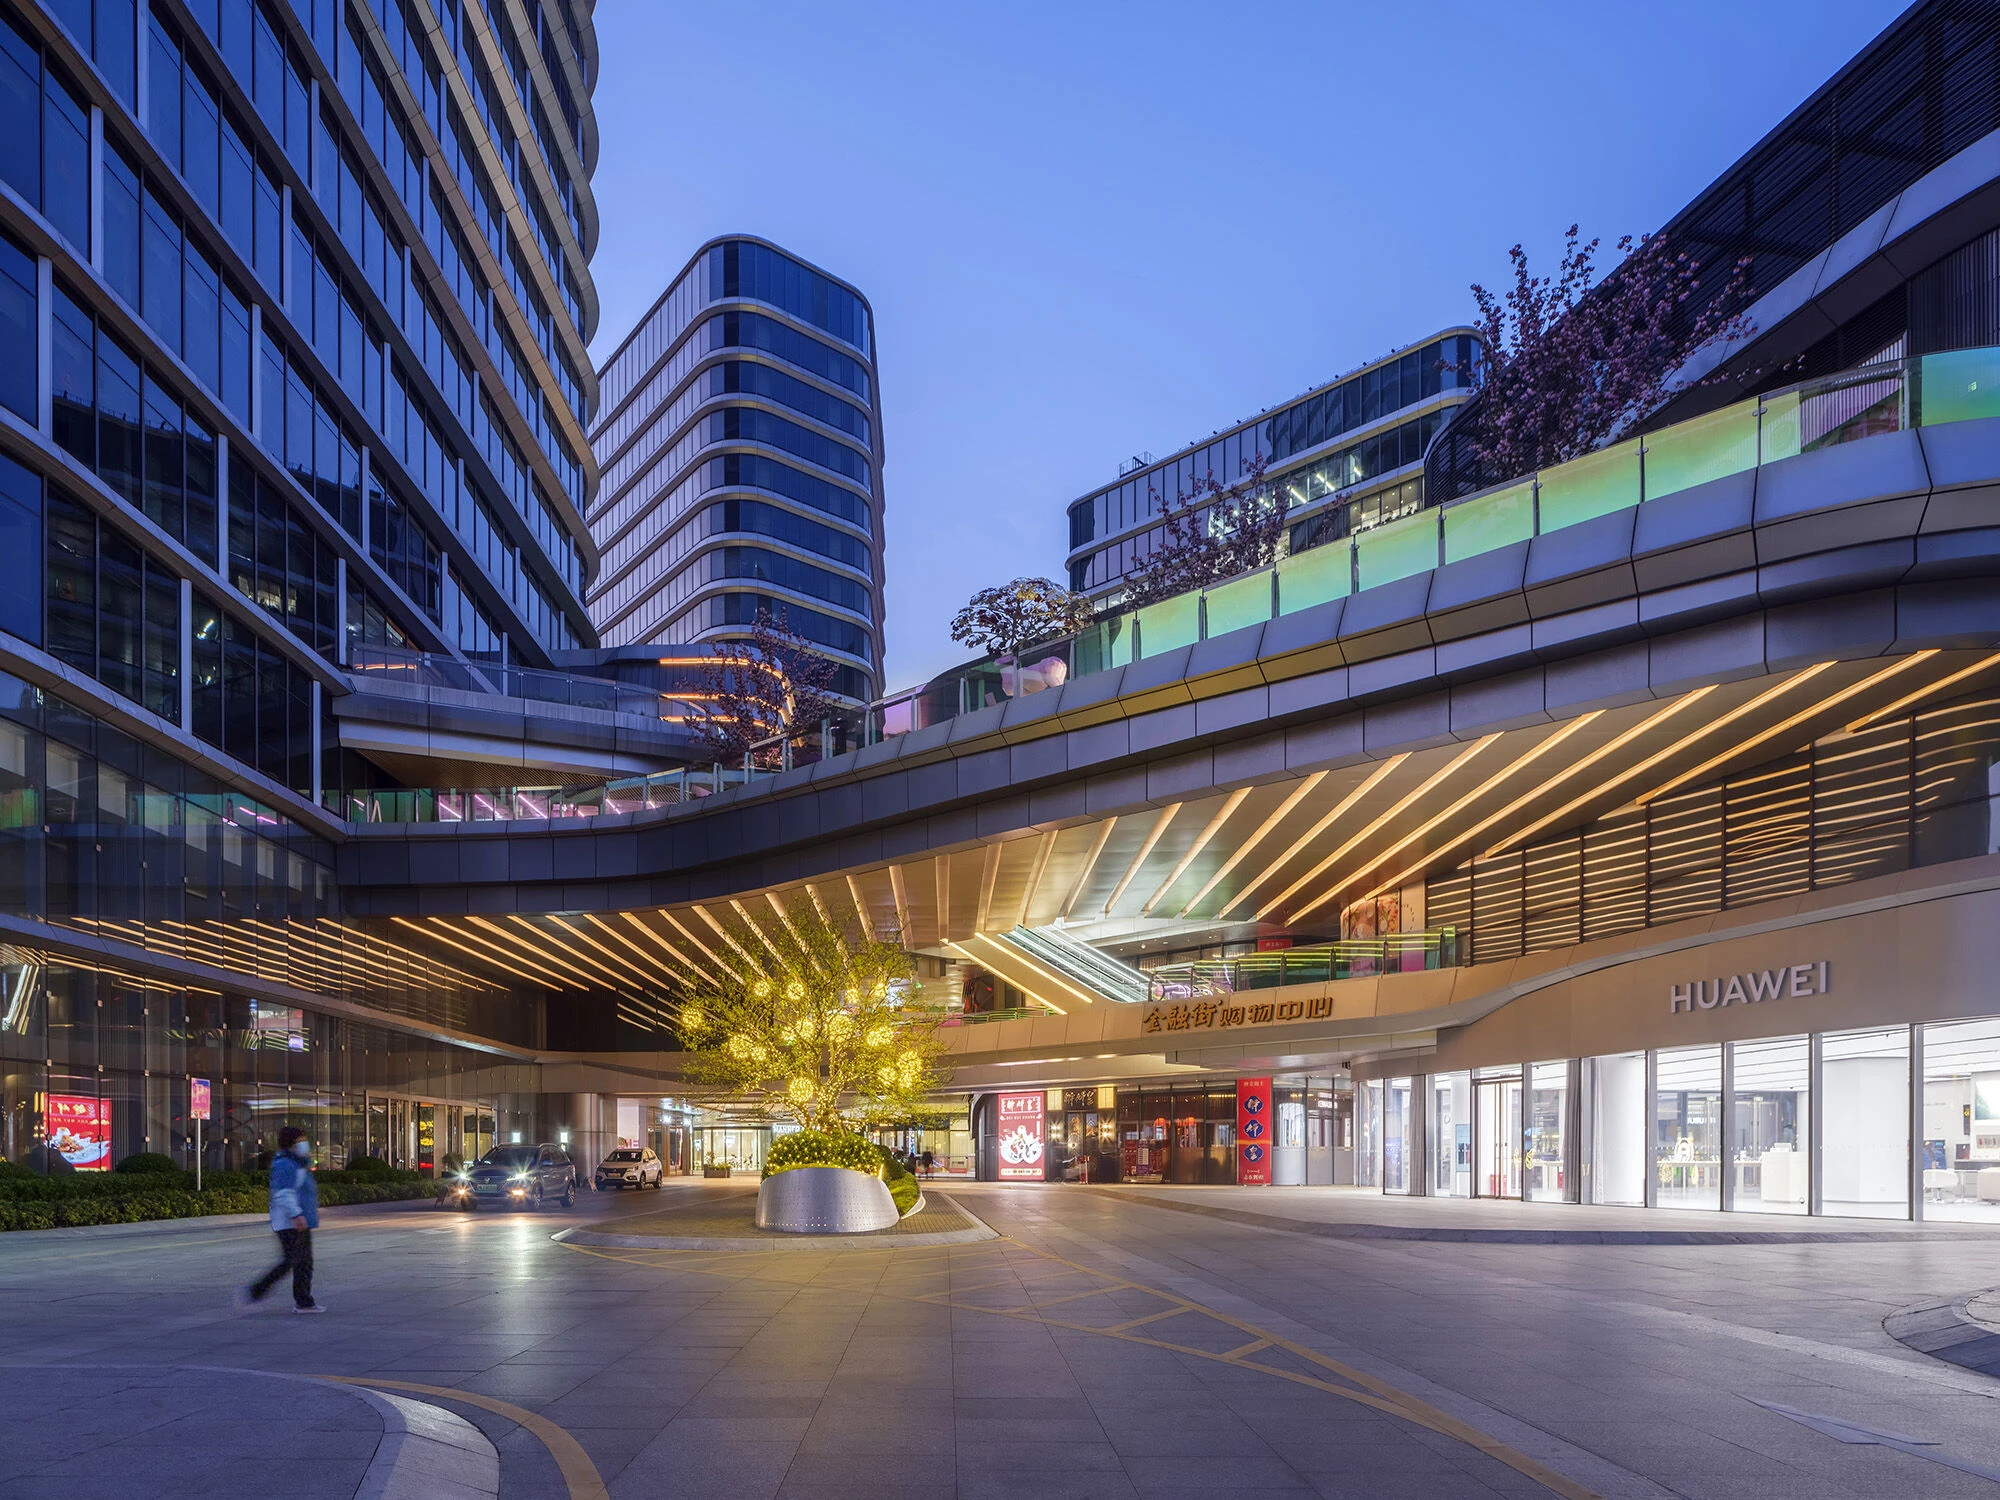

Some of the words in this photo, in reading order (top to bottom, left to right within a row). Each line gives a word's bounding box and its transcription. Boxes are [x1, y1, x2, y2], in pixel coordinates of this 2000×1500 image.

[1671, 961, 1828, 1013] HUAWEI
[1144, 997, 1332, 1032] 金融街购物中心
